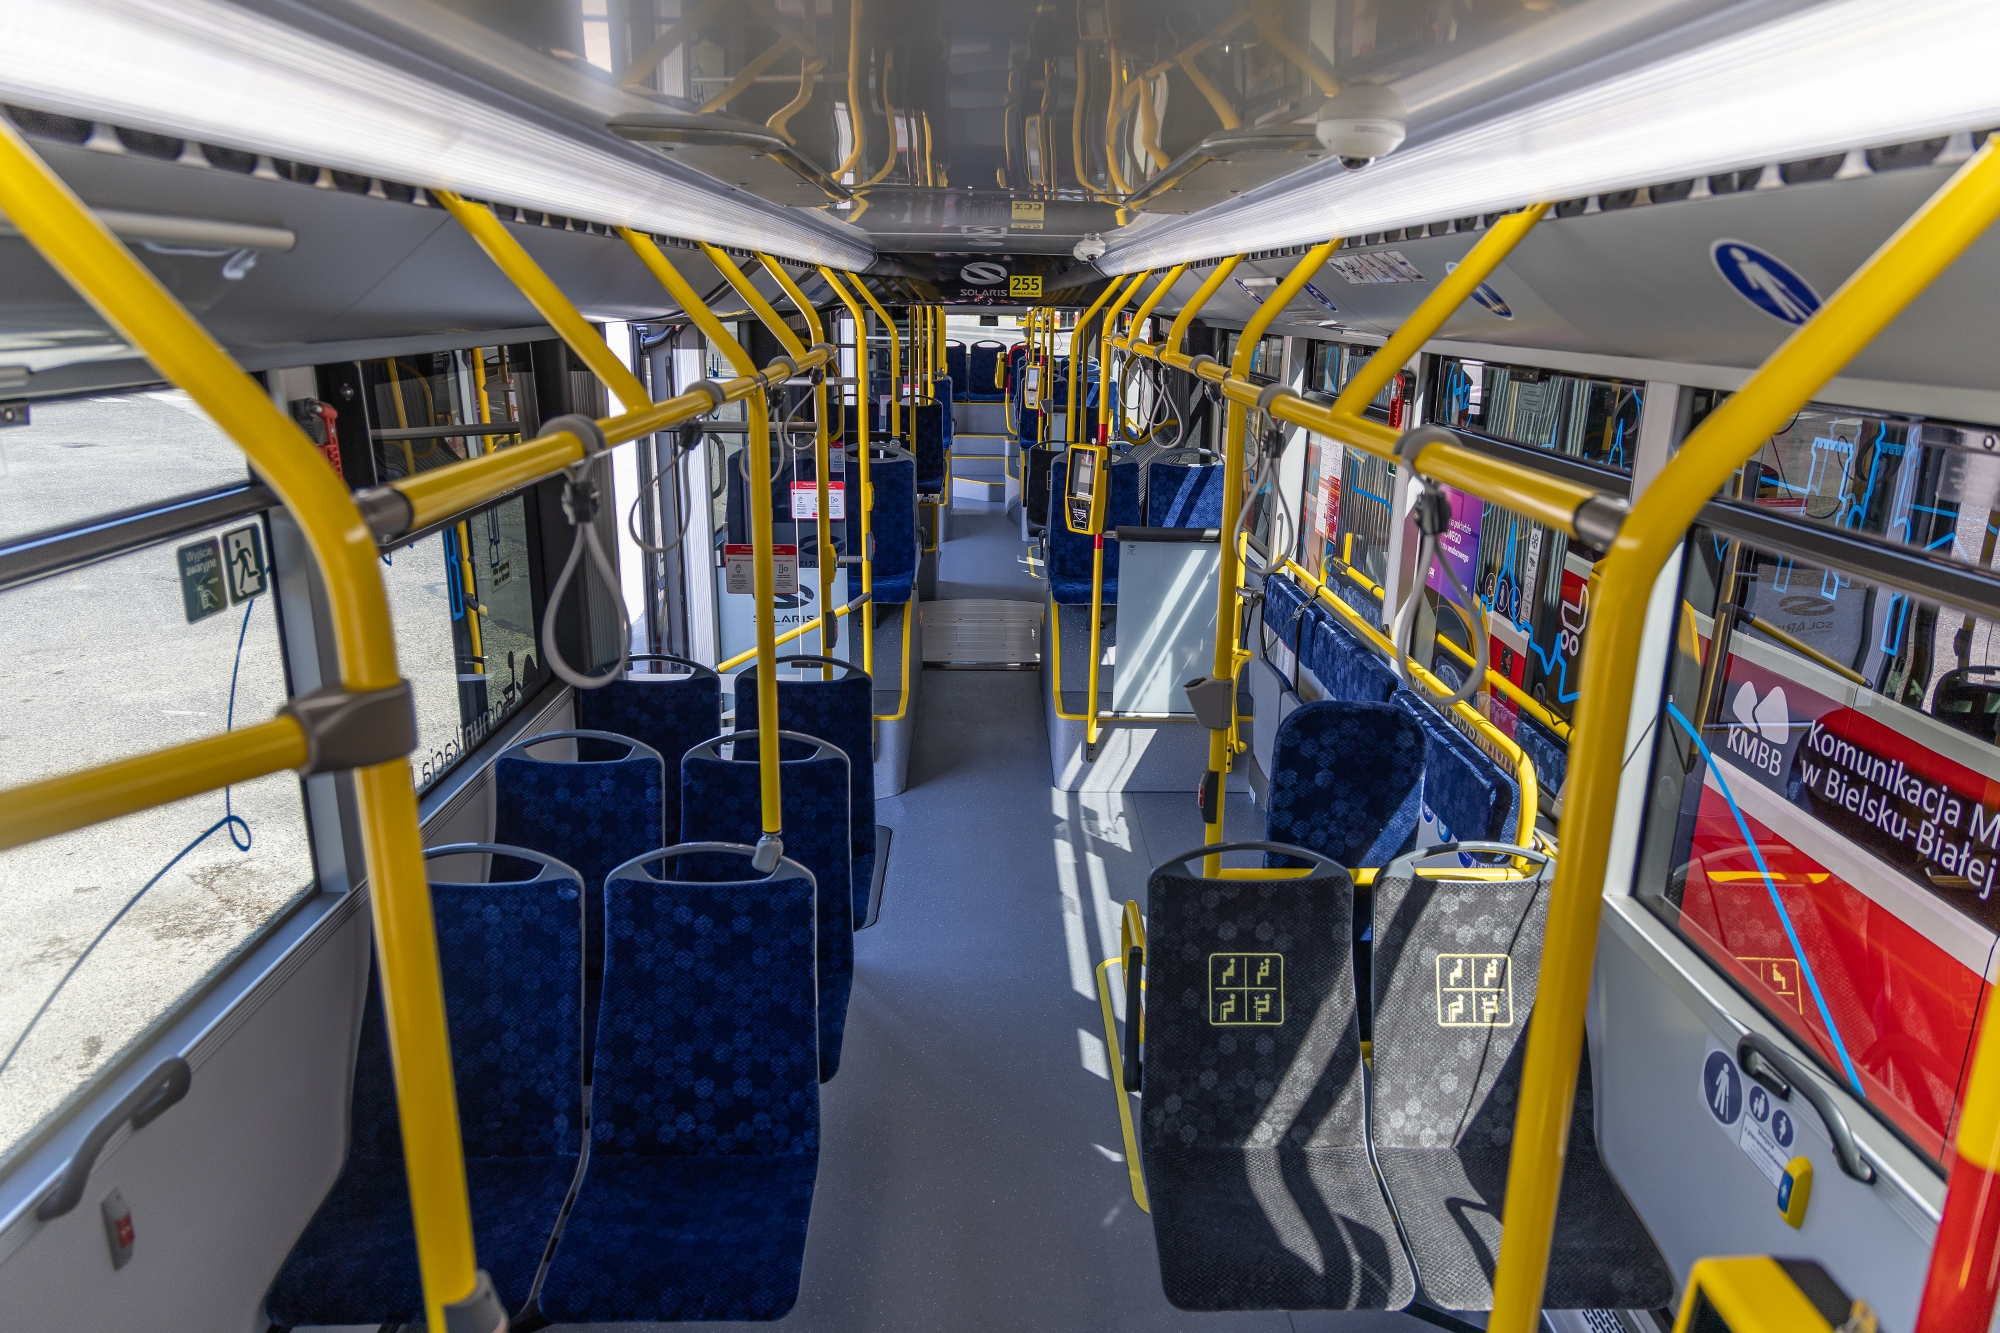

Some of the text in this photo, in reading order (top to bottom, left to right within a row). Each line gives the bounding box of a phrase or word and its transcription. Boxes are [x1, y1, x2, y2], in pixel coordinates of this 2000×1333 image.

[960, 289, 1008, 297] SOLARIS
[1012, 277, 1040, 291] 255
[185, 547, 213, 563] Wyjście
[186, 559, 217, 577] awaryjne
[1726, 724, 1783, 777] KMBB
[1807, 719, 1962, 829] Komunikacja
[1800, 759, 1999, 900] w Bielsku-Białej
